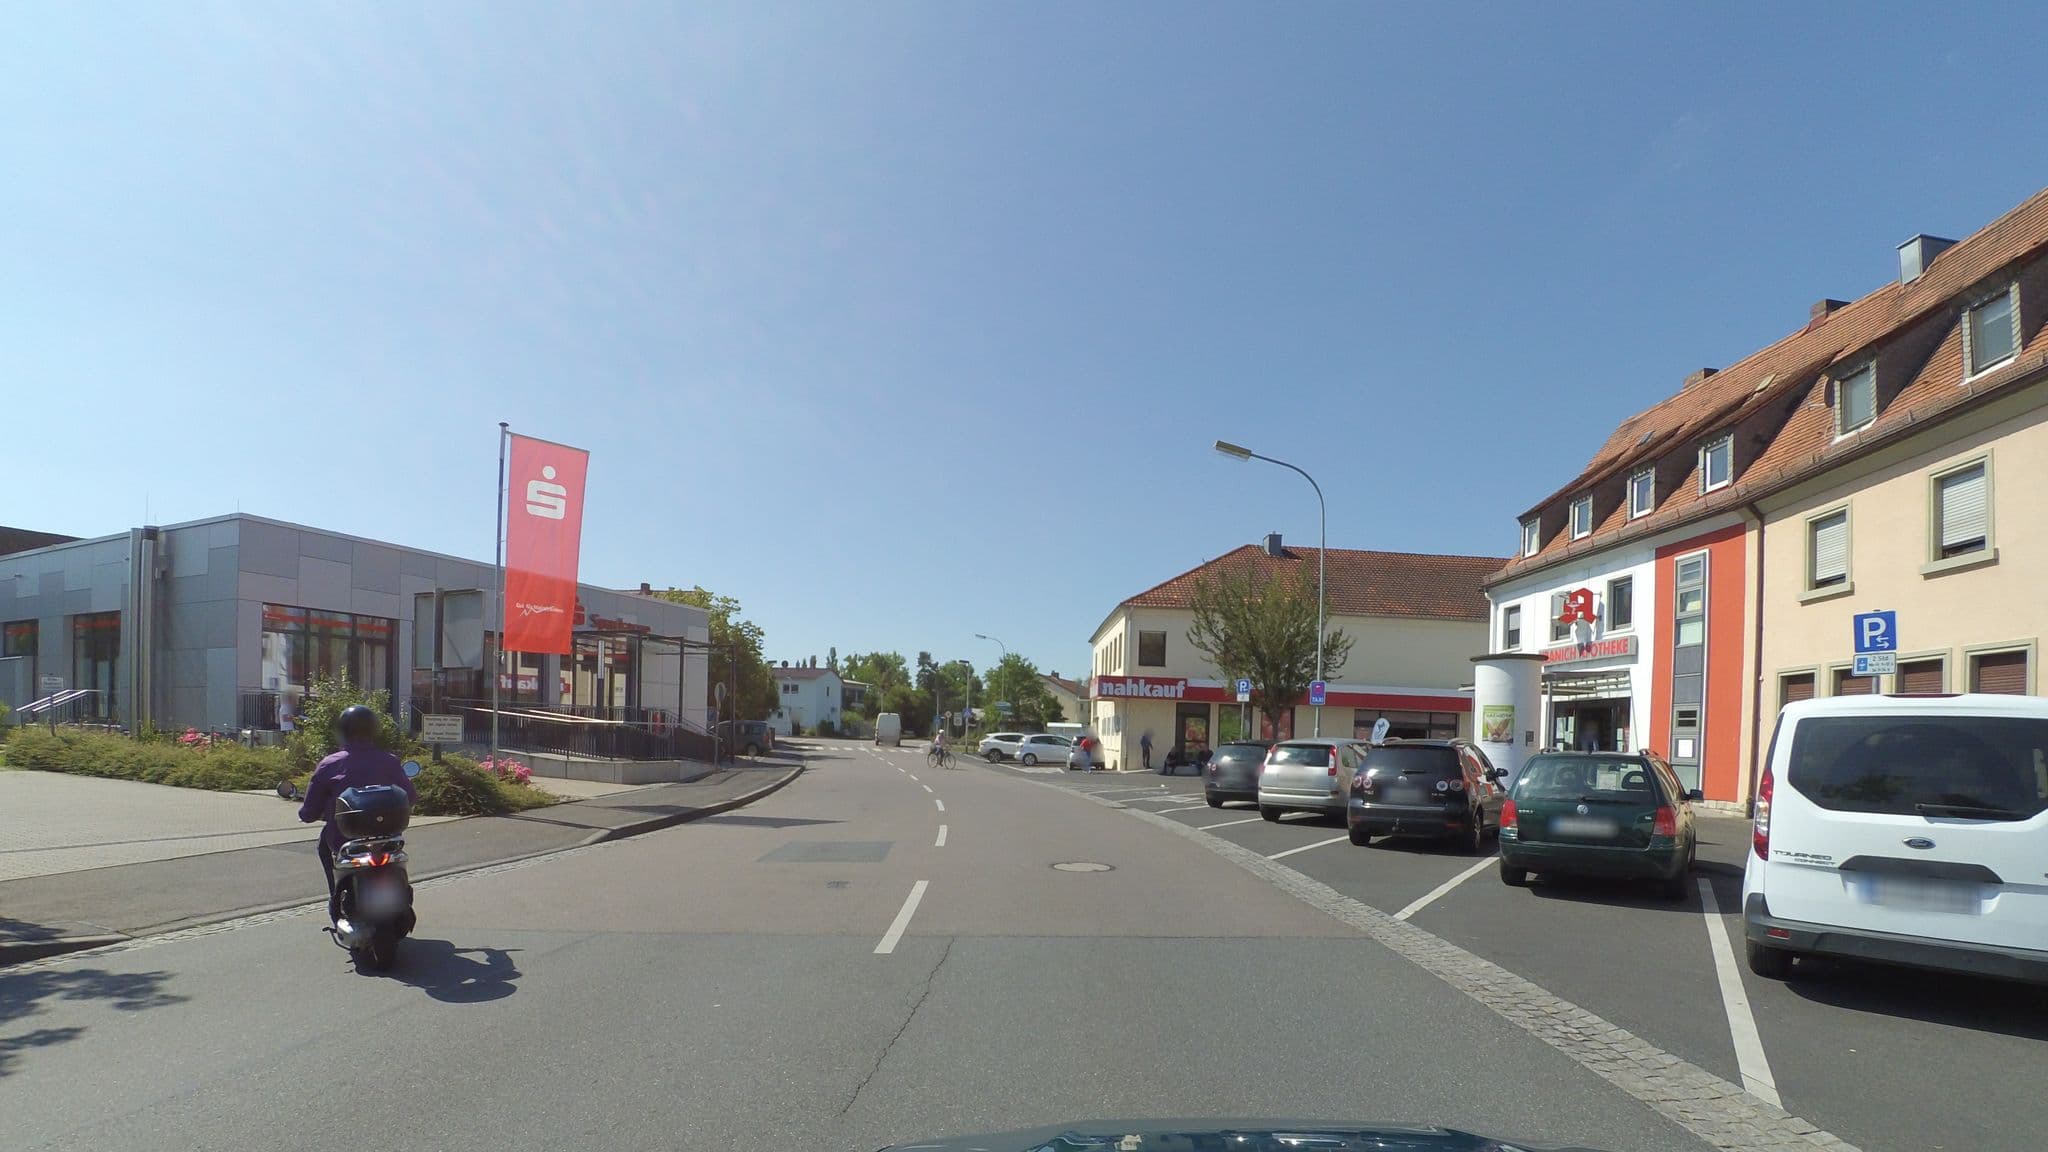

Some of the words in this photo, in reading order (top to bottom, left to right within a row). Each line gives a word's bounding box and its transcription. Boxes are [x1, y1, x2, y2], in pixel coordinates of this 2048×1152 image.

[1863, 617, 1886, 648] P
[1102, 678, 1186, 698] nahkauf
[1239, 681, 1247, 692] P
[1773, 849, 1833, 861] TOURNEO
[1794, 858, 1836, 866] CONNECT
